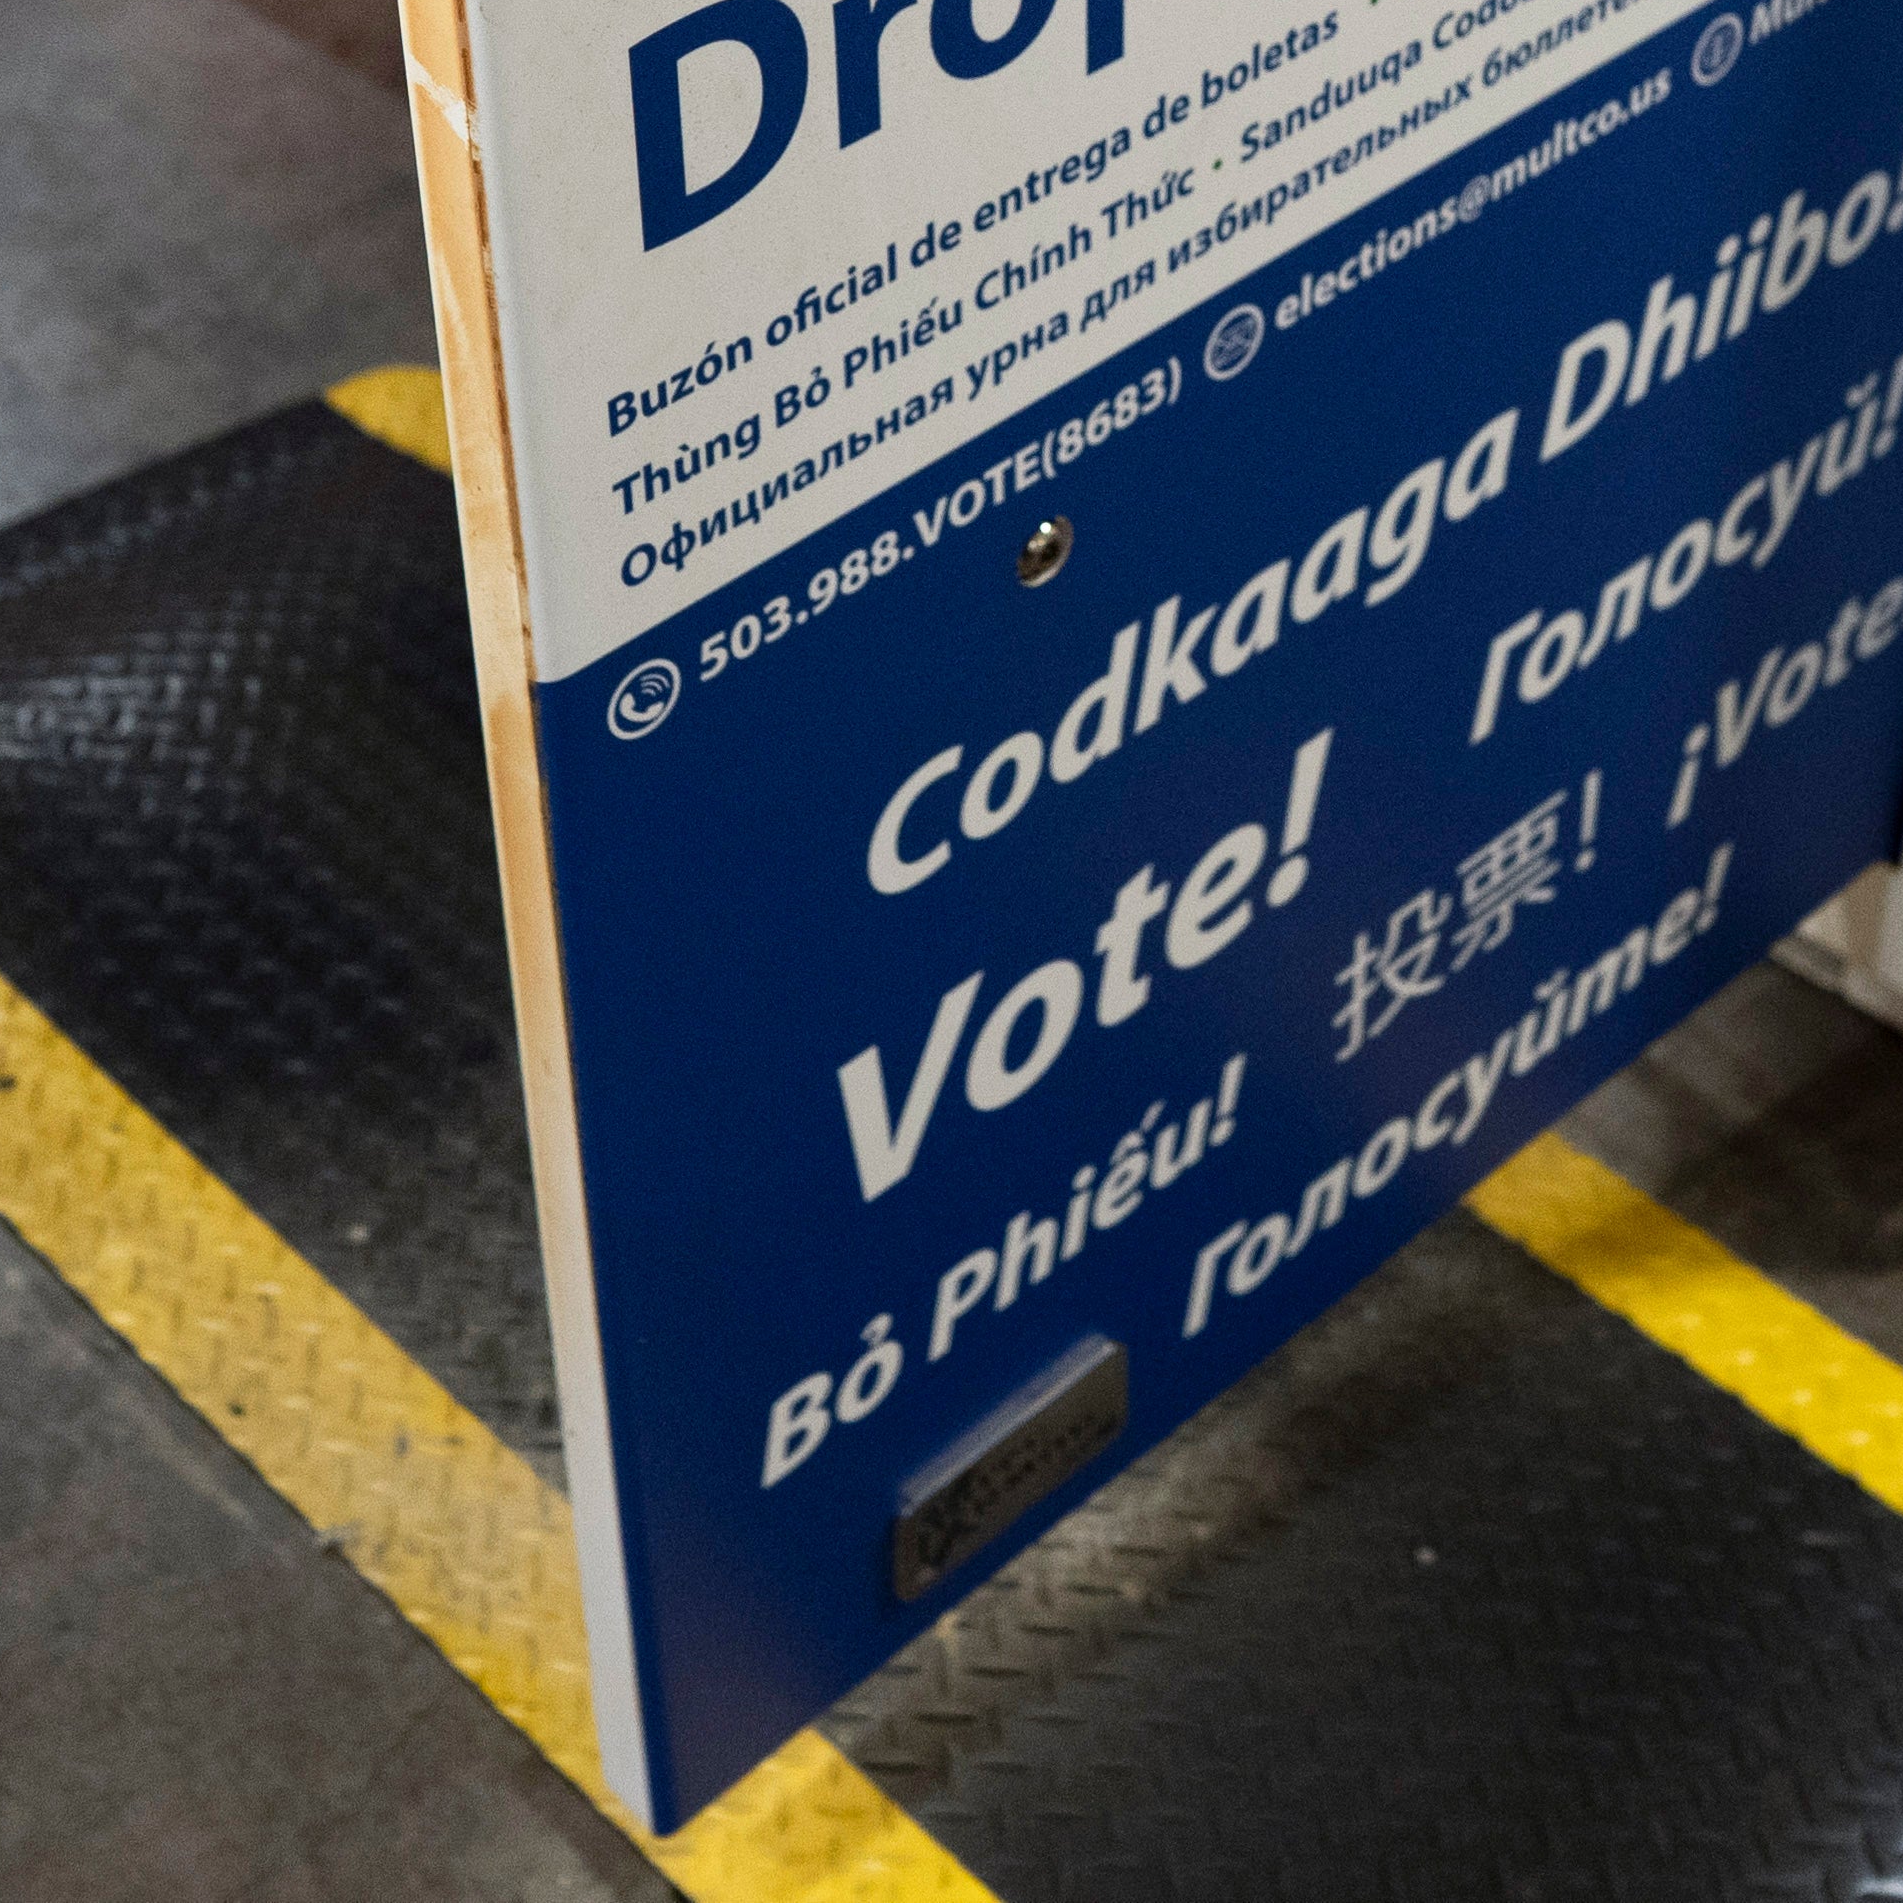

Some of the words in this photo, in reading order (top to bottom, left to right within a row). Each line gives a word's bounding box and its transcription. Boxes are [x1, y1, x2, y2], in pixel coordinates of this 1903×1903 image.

[607, 334, 752, 437] Buzón
[765, 243, 898, 348] oficial
[909, 219, 961, 269] de
[973, 128, 1133, 233] entrega
[1142, 92, 1190, 141] de
[1200, 10, 1340, 111] boletas
[1239, 39, 1422, 163] Sanduuqa
[1274, 66, 1672, 330] elections@multco.us
[612, 413, 761, 516] Thùng
[775, 362, 830, 428] Bỏ
[843, 291, 962, 389] Phiếu
[974, 222, 1092, 311] Chính
[1101, 163, 1196, 245] Thức
[620, 373, 954, 589] Официальная
[965, 307, 1069, 401] урна
[1080, 251, 1156, 332] для
[1167, 74, 1472, 276] избирательных
[699, 354, 1183, 681] 503.988.VOTE(8683)
[866, 407, 1520, 896] Codkaaga
[837, 727, 1334, 1203] Vote!
[761, 1313, 903, 1489] Bỏ
[927, 1054, 1244, 1361] Phiếu!
